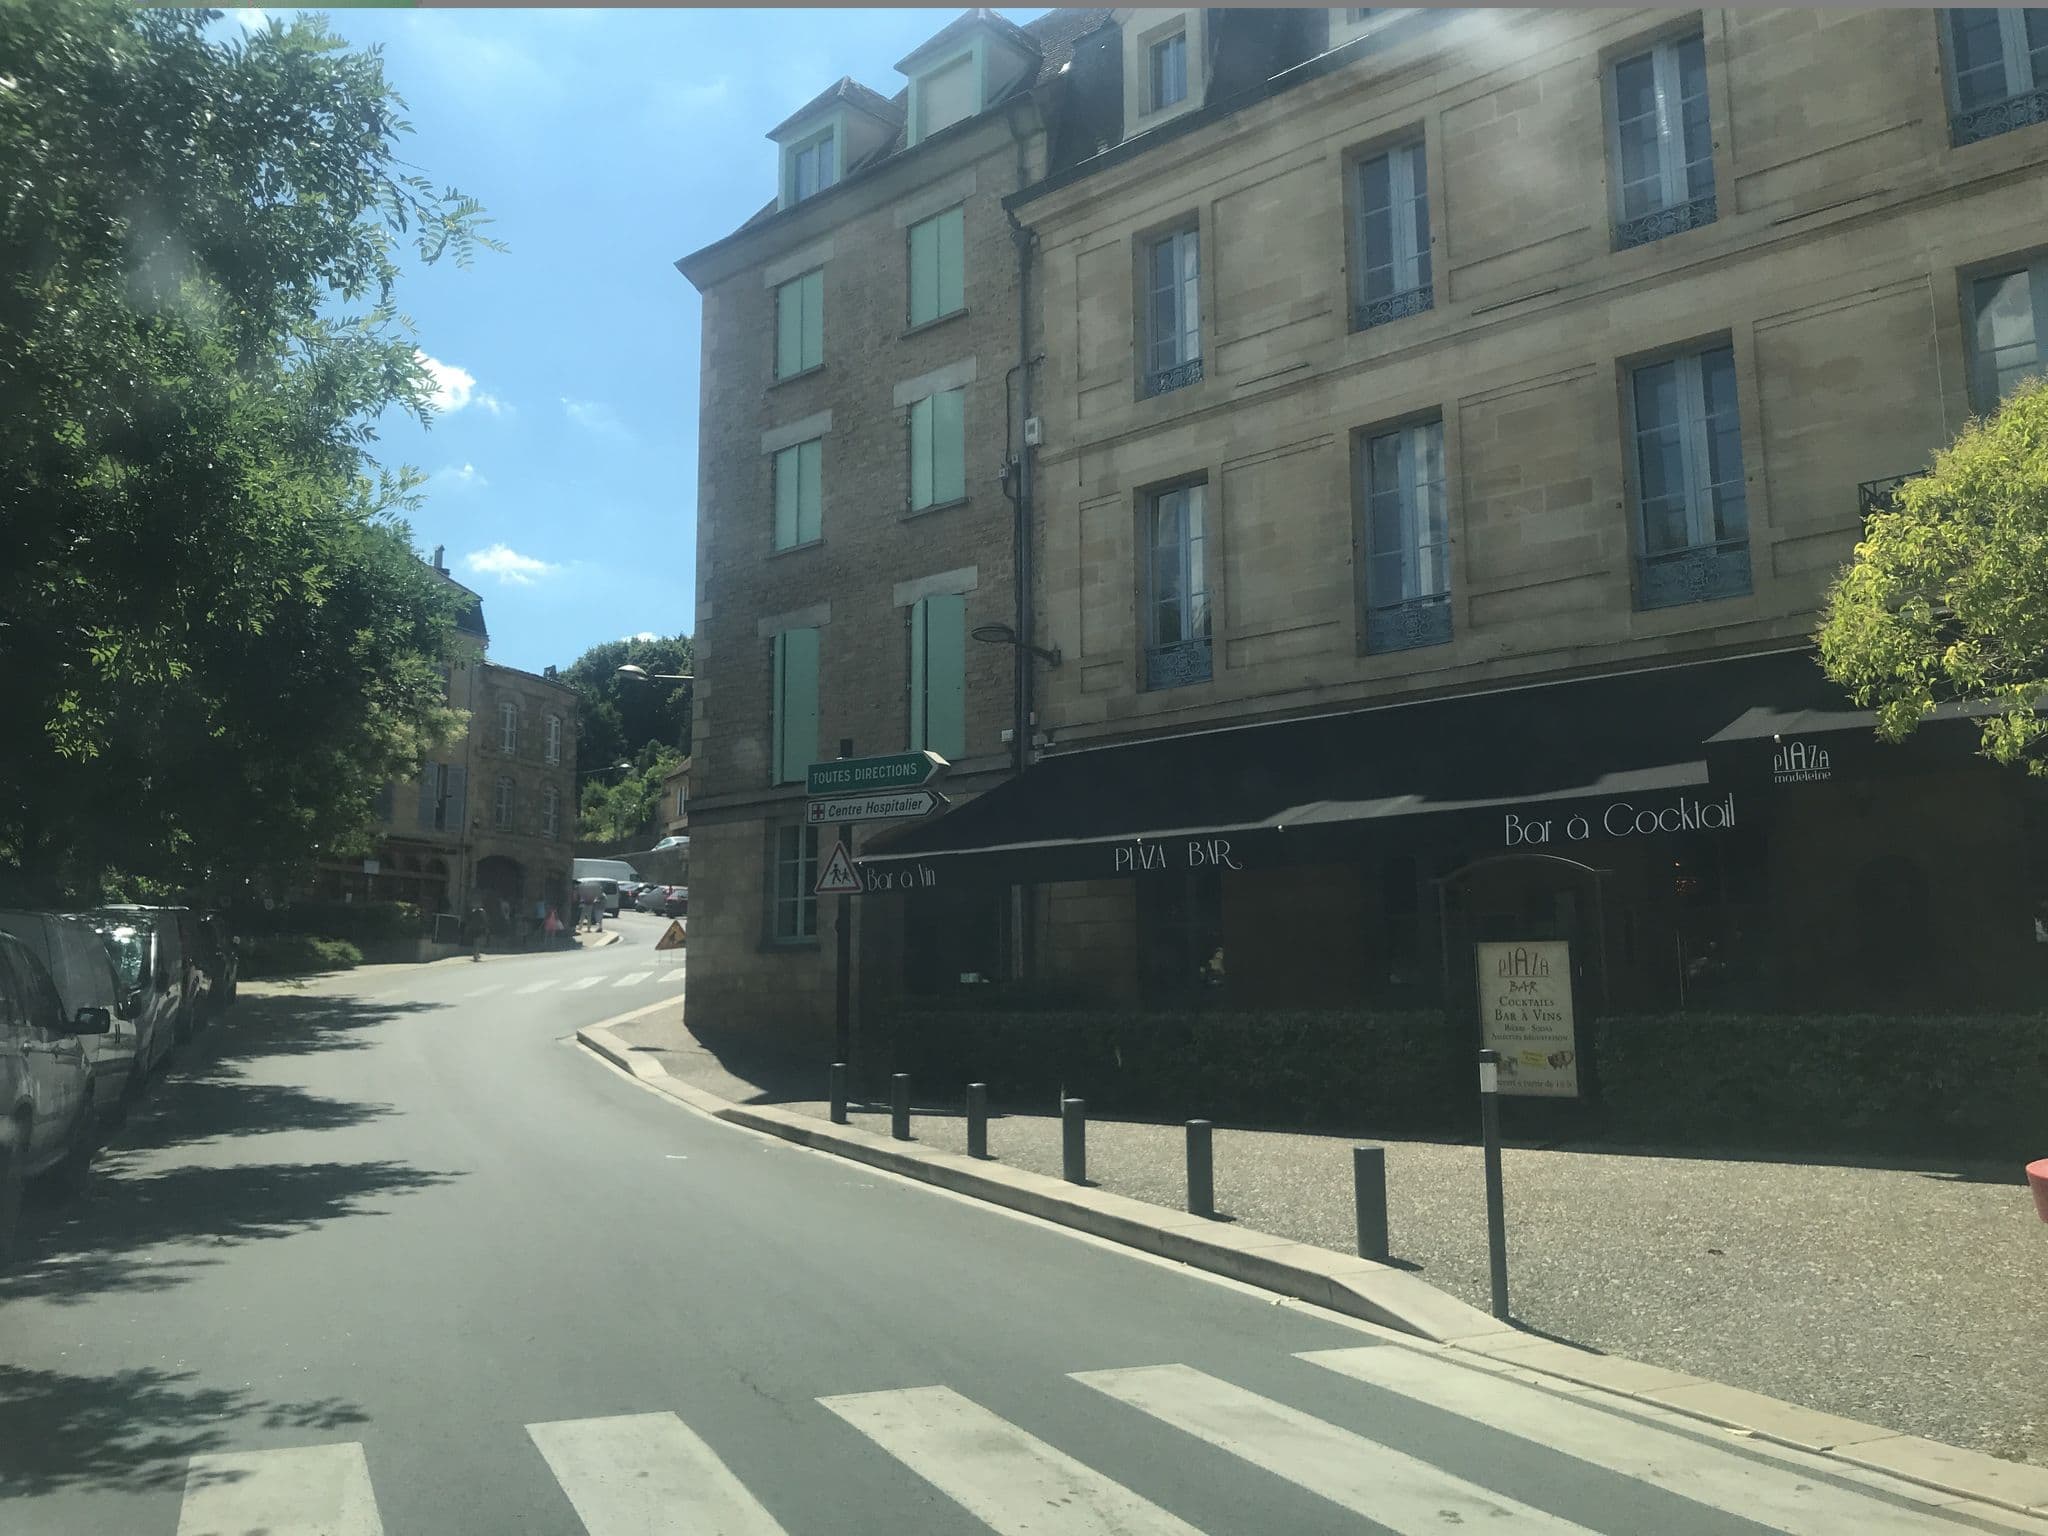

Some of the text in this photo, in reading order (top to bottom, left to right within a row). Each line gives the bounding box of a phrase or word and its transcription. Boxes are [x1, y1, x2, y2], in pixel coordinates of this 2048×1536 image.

[813, 762, 918, 785] TOUTES DIRECTIONS
[828, 798, 923, 817] Centre Hospitalier
[1505, 792, 1736, 846] Bar à Cocktail
[1115, 839, 1243, 872] PLAZA BAR
[867, 868, 893, 892] Bar
[1509, 980, 1538, 995] BAR
[1495, 1008, 1517, 1021] BAR
[1533, 1008, 1562, 1021] VINS
